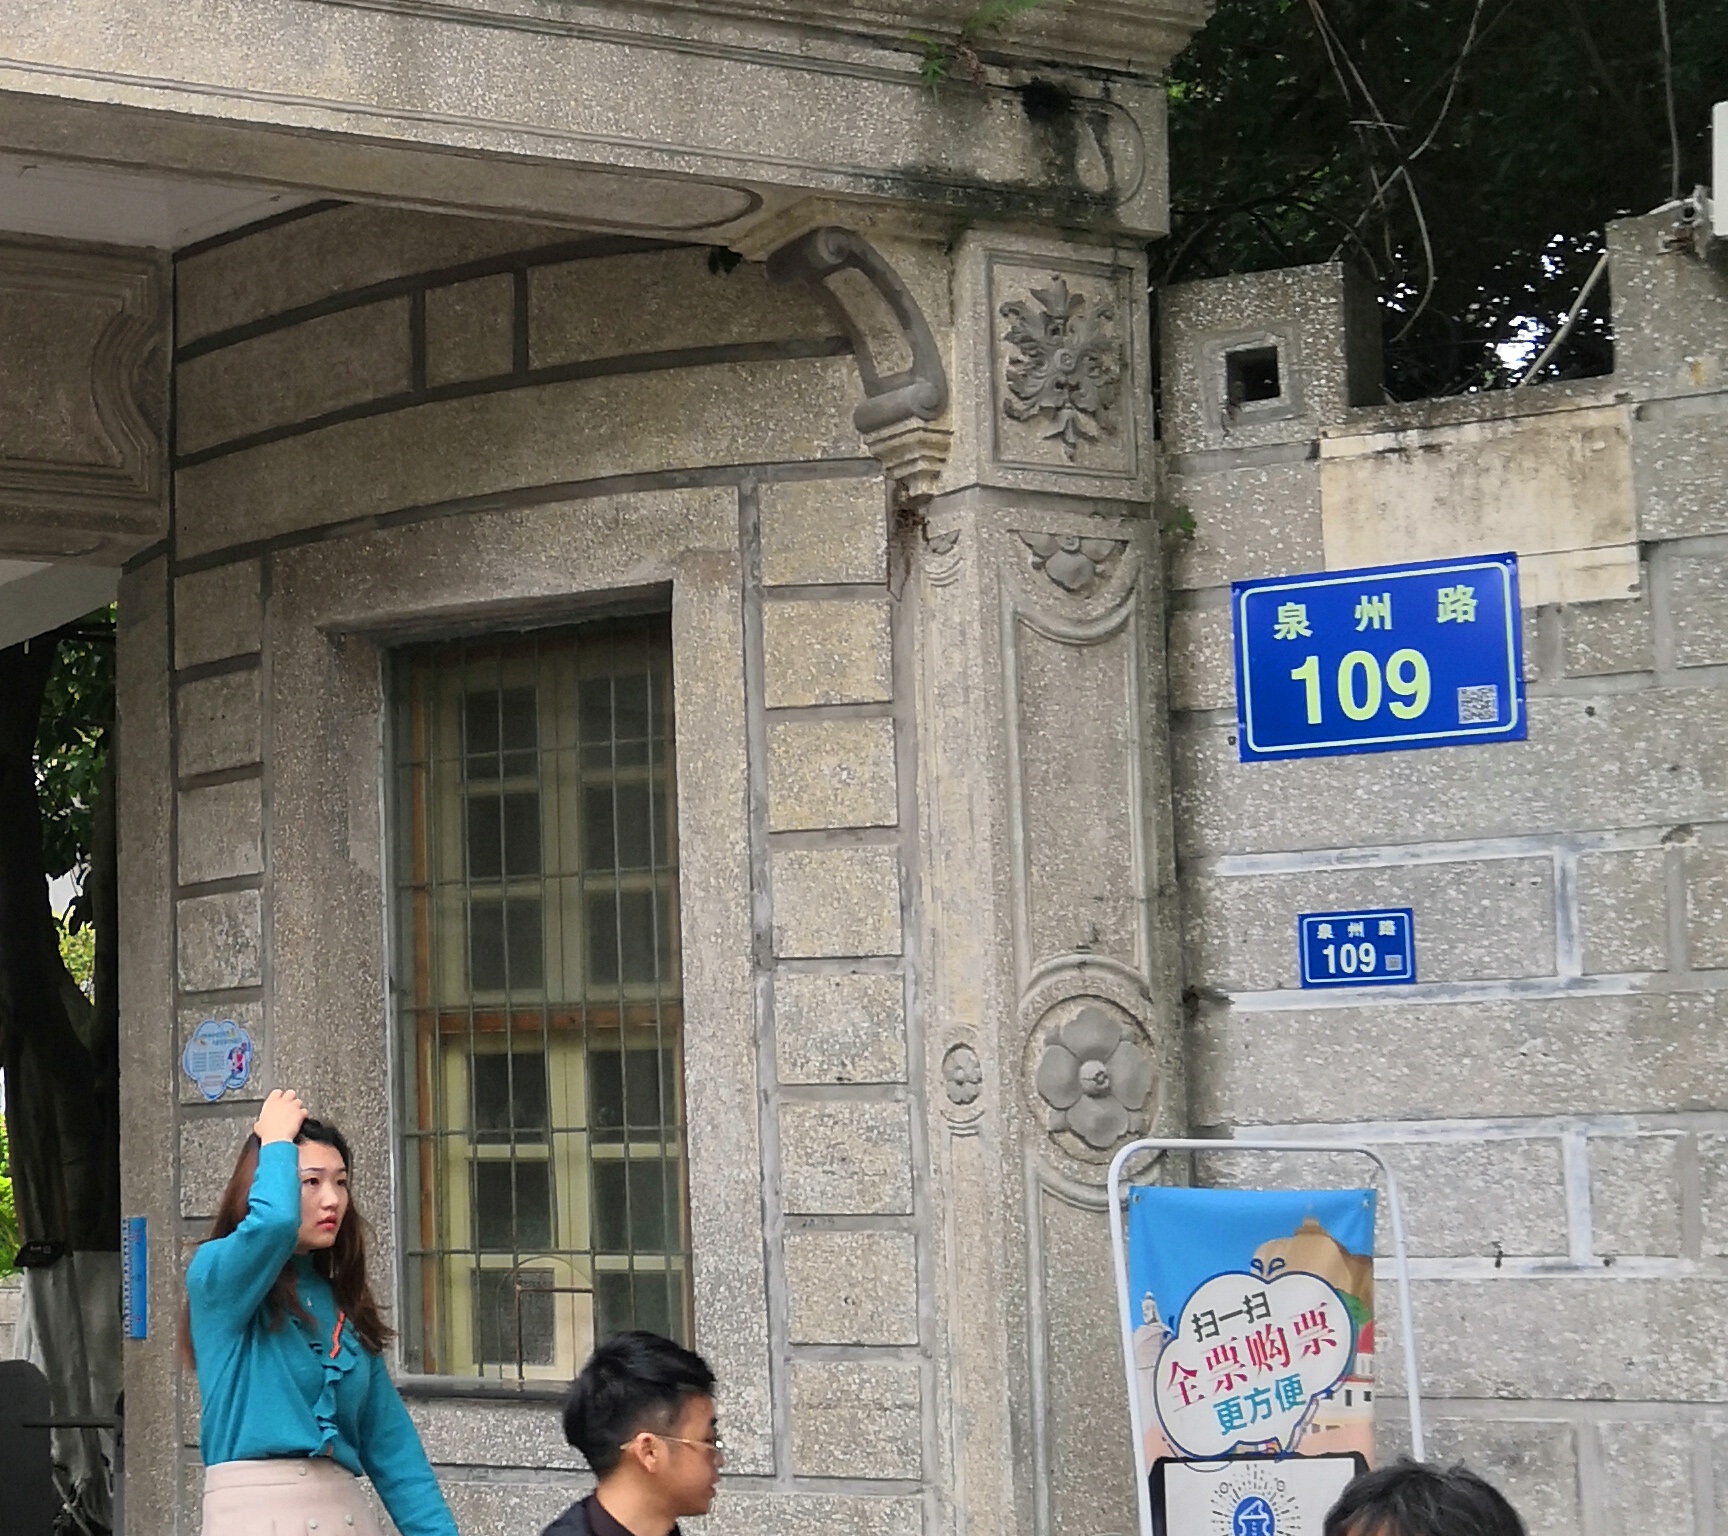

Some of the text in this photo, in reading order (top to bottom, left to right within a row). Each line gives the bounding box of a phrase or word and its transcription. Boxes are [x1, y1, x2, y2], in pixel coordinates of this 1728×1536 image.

[1274, 586, 1479, 640] 泉州路
[1290, 649, 1431, 725] 109
[1316, 920, 1396, 939] 泉州路
[1322, 943, 1377, 974] 109
[1191, 1291, 1273, 1343] 扫一扫
[1167, 1302, 1338, 1414] 全票购票
[1213, 1374, 1307, 1437] 更方便
